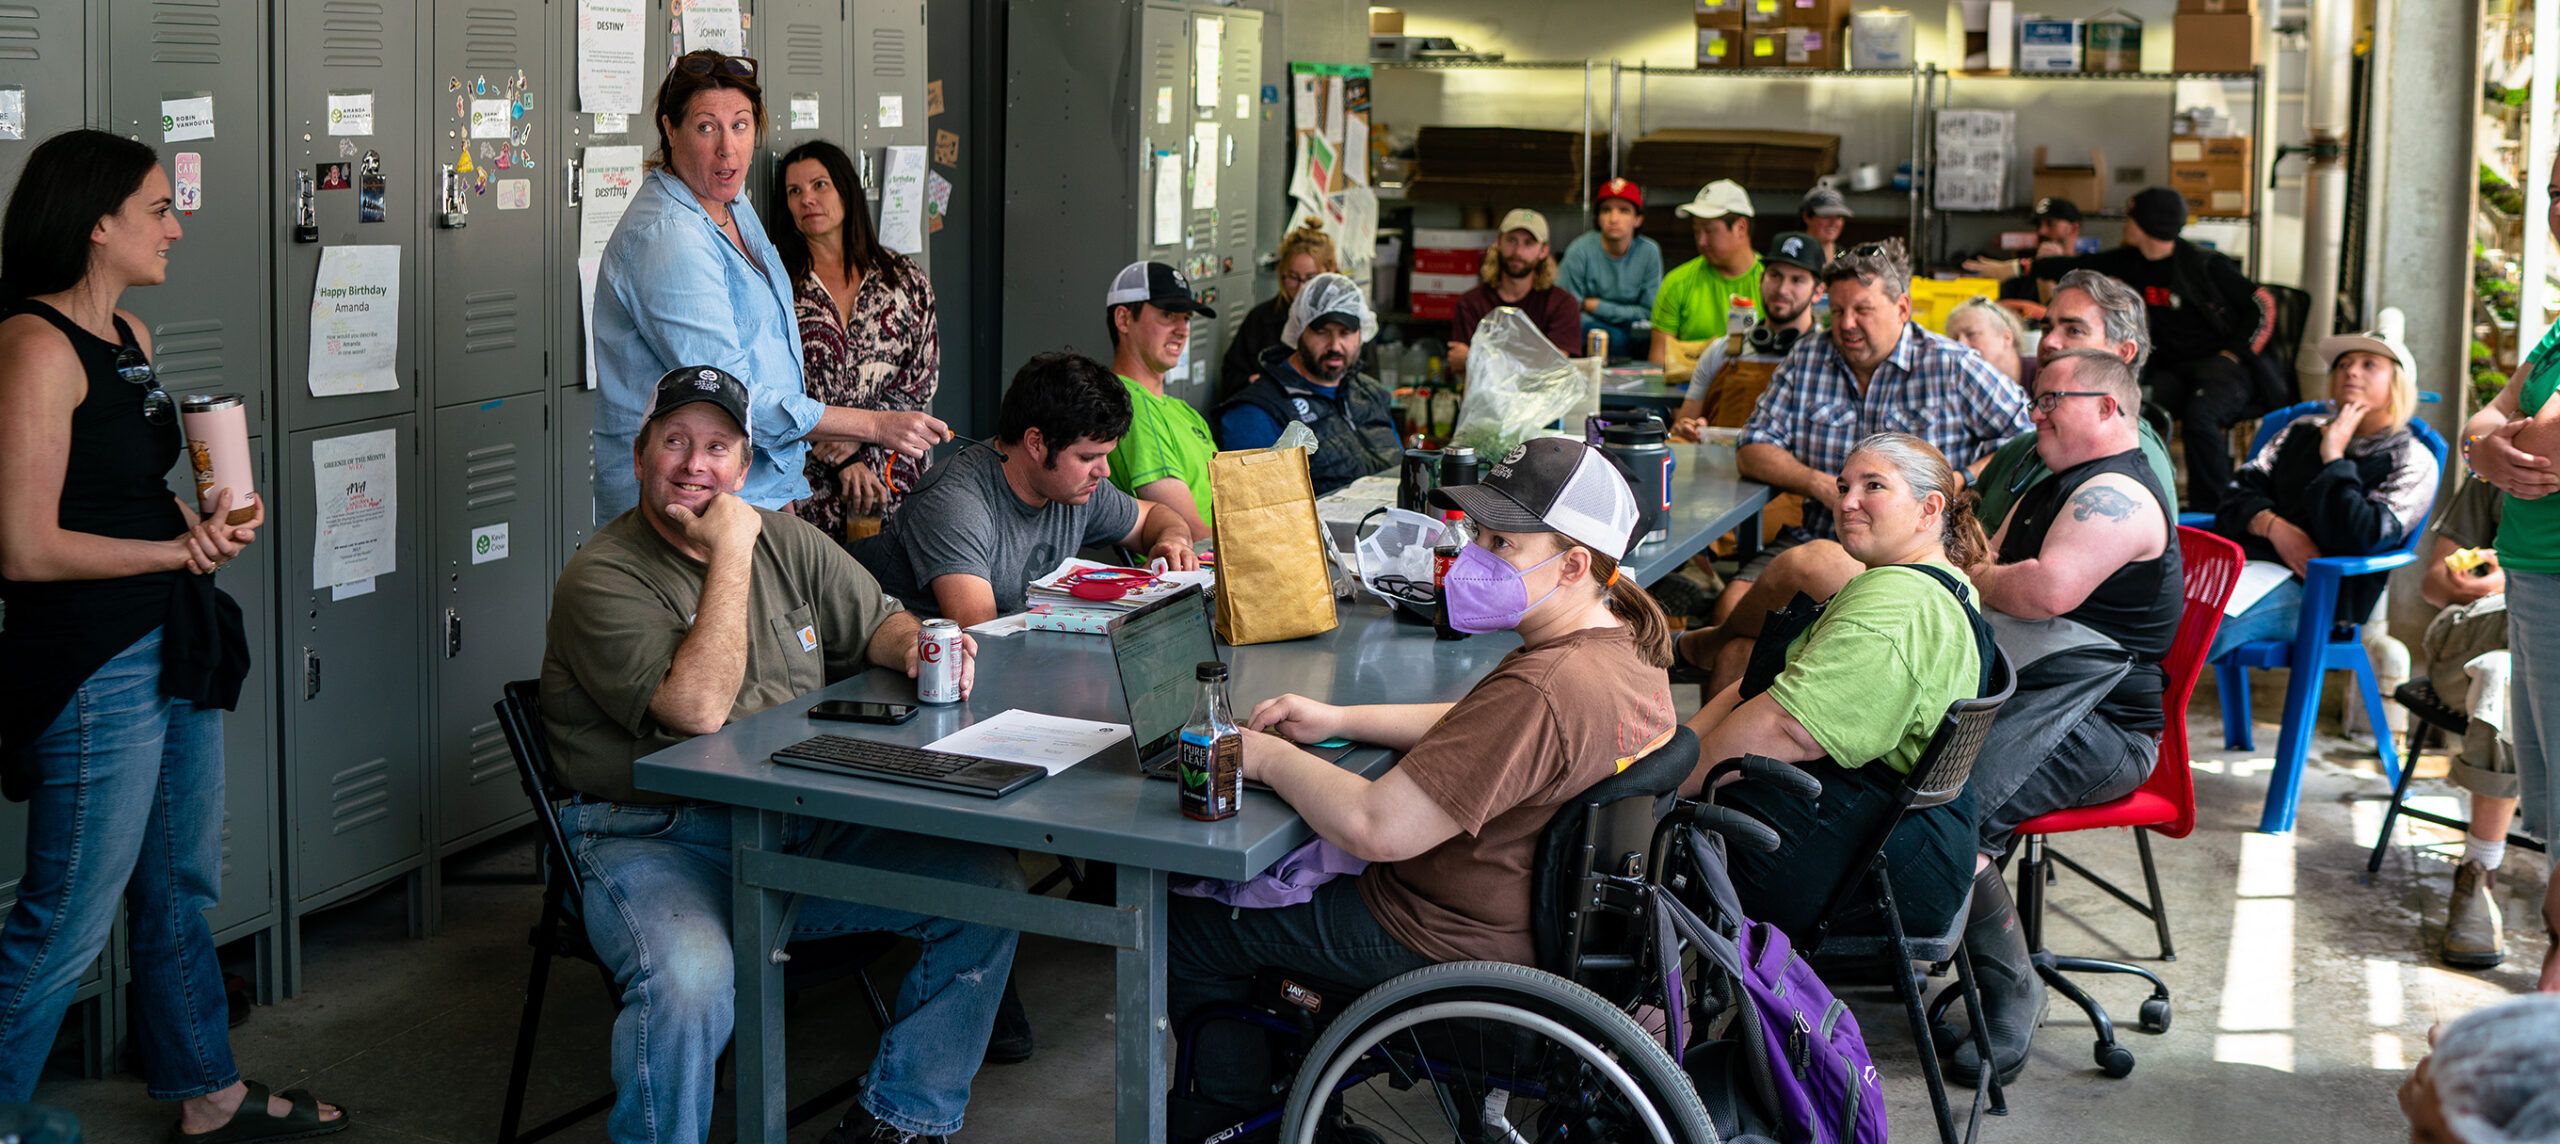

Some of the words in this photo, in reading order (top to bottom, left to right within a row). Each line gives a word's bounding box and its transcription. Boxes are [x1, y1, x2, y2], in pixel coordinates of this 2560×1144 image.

[596, 21, 625, 31] DESTINY
[699, 28, 727, 38] JOHNNY
[177, 162, 199, 175] CAKE
[320, 287, 346, 298] Happy
[348, 285, 387, 297] Birthday
[335, 302, 369, 313] Amanda
[347, 458, 355, 467] OF
[355, 456, 366, 466] THE
[366, 453, 386, 463] MONTH
[491, 533, 506, 541] Kevin
[1183, 743, 1206, 757] PURE
[1183, 753, 1206, 768] LEAF
[1287, 984, 1303, 997] JAY
[1234, 1121, 1244, 1133] T
